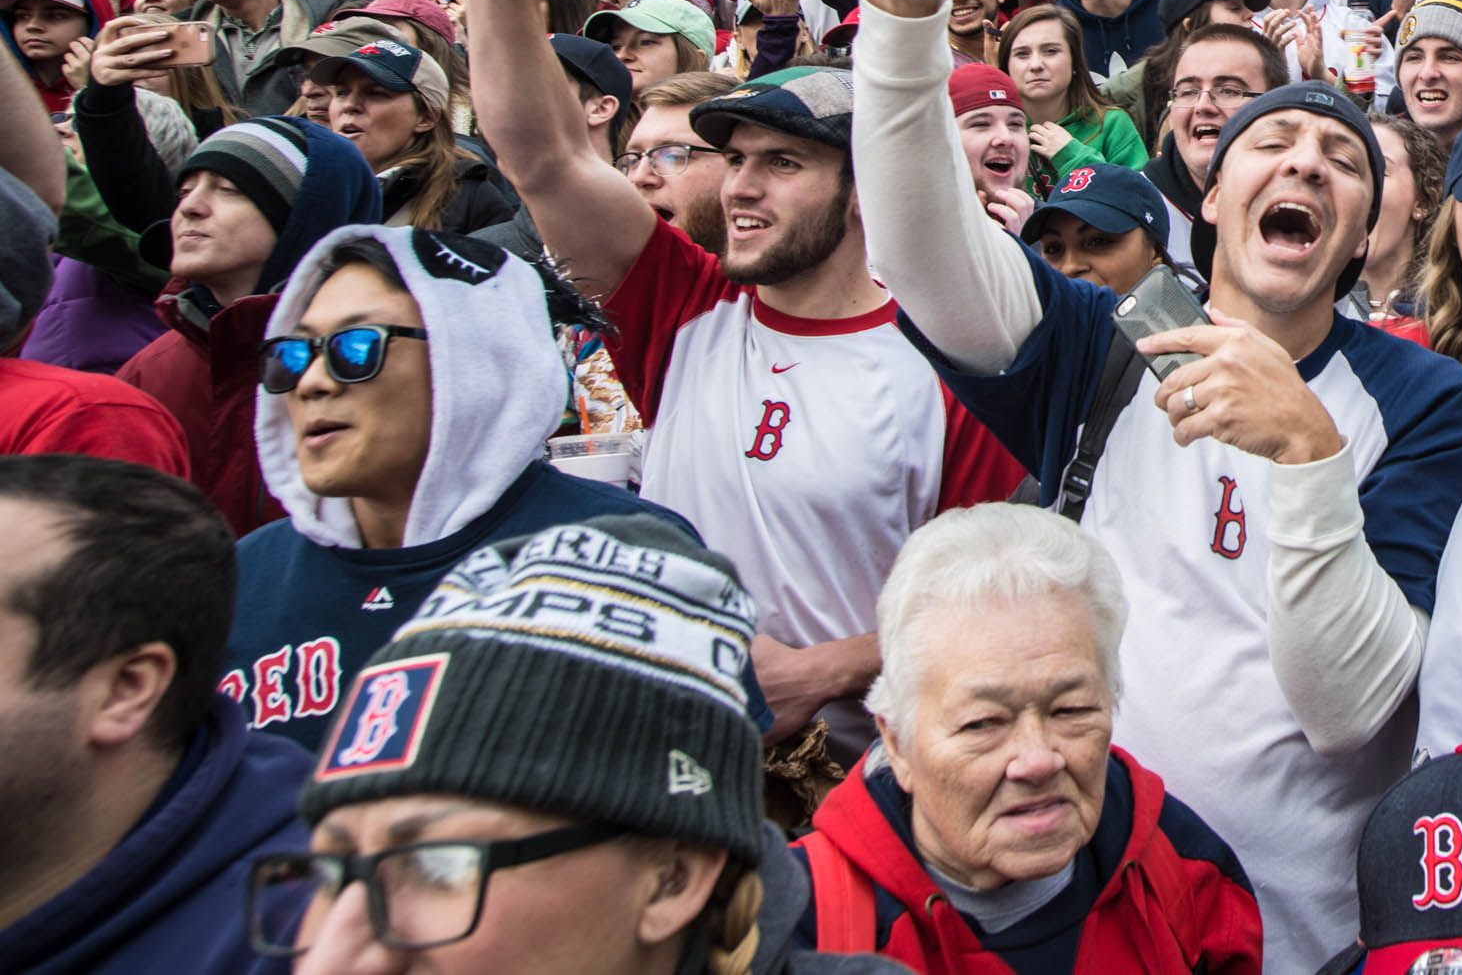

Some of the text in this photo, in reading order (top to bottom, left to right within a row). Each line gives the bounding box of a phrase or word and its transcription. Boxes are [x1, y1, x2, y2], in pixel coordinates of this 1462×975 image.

[1061, 166, 1097, 194] B
[745, 399, 791, 461] B
[1210, 475, 1247, 560] B
[338, 670, 410, 766] B
